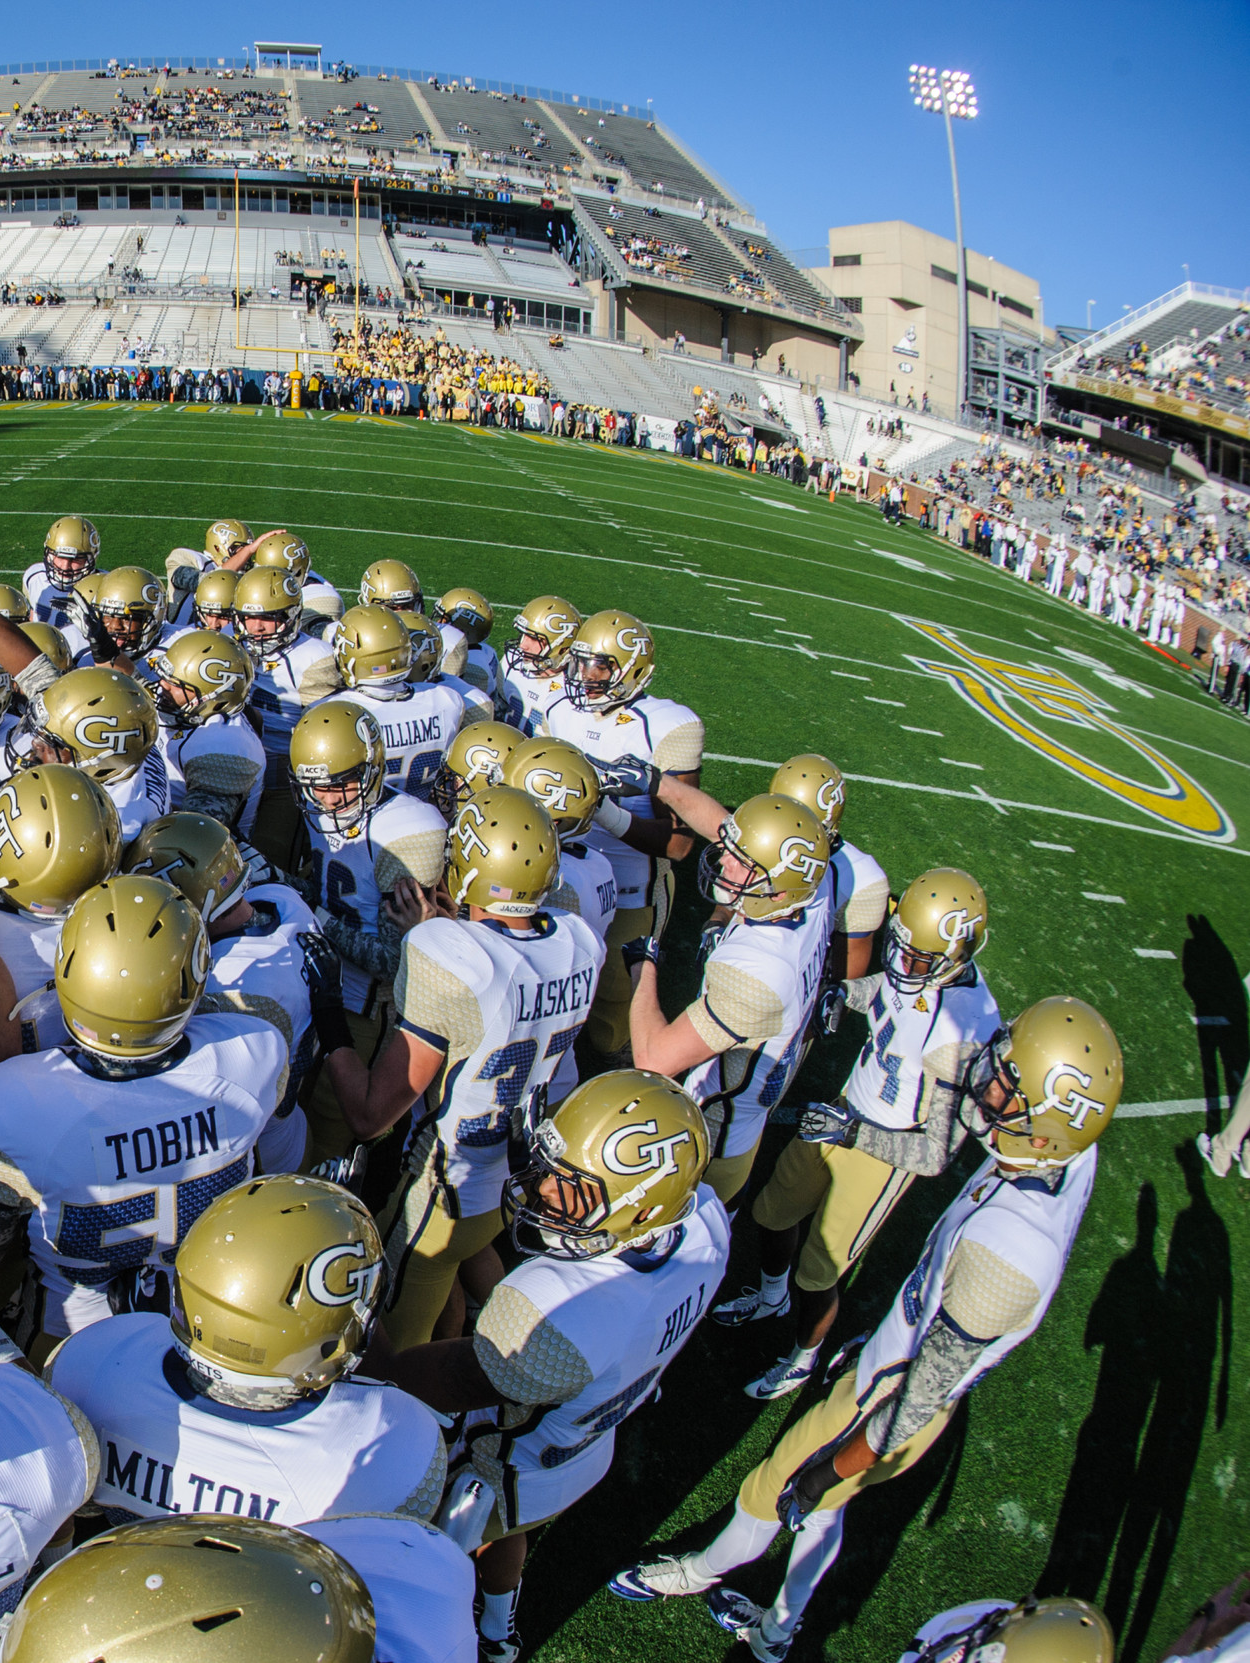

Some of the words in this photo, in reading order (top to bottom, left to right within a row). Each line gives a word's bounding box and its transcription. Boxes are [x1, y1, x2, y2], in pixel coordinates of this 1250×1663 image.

[386, 179, 411, 189] 24:21
[456, 601, 485, 627] GT
[544, 613, 579, 639] GT
[616, 628, 651, 656] GT
[199, 658, 245, 692] GT
[527, 690, 539, 701] TECH
[75, 715, 141, 756] GT
[586, 731, 601, 741] TECH
[524, 768, 581, 811] GT
[816, 777, 846, 812] GT
[457, 803, 490, 862] GT
[779, 836, 826, 885] GT
[499, 903, 536, 915] JACKETS
[515, 891, 527, 900] 37
[937, 908, 984, 945] GT
[516, 967, 593, 1023] LASKEY
[891, 994, 903, 1013] TECH
[1043, 1062, 1106, 1131] GT
[104, 1105, 220, 1181] TOBIN
[602, 1119, 691, 1177] GT
[193, 1324, 203, 1342] 18
[656, 1282, 707, 1356] HILL
[174, 1341, 224, 1381] JACKETS
[105, 1440, 280, 1522] MILTON
